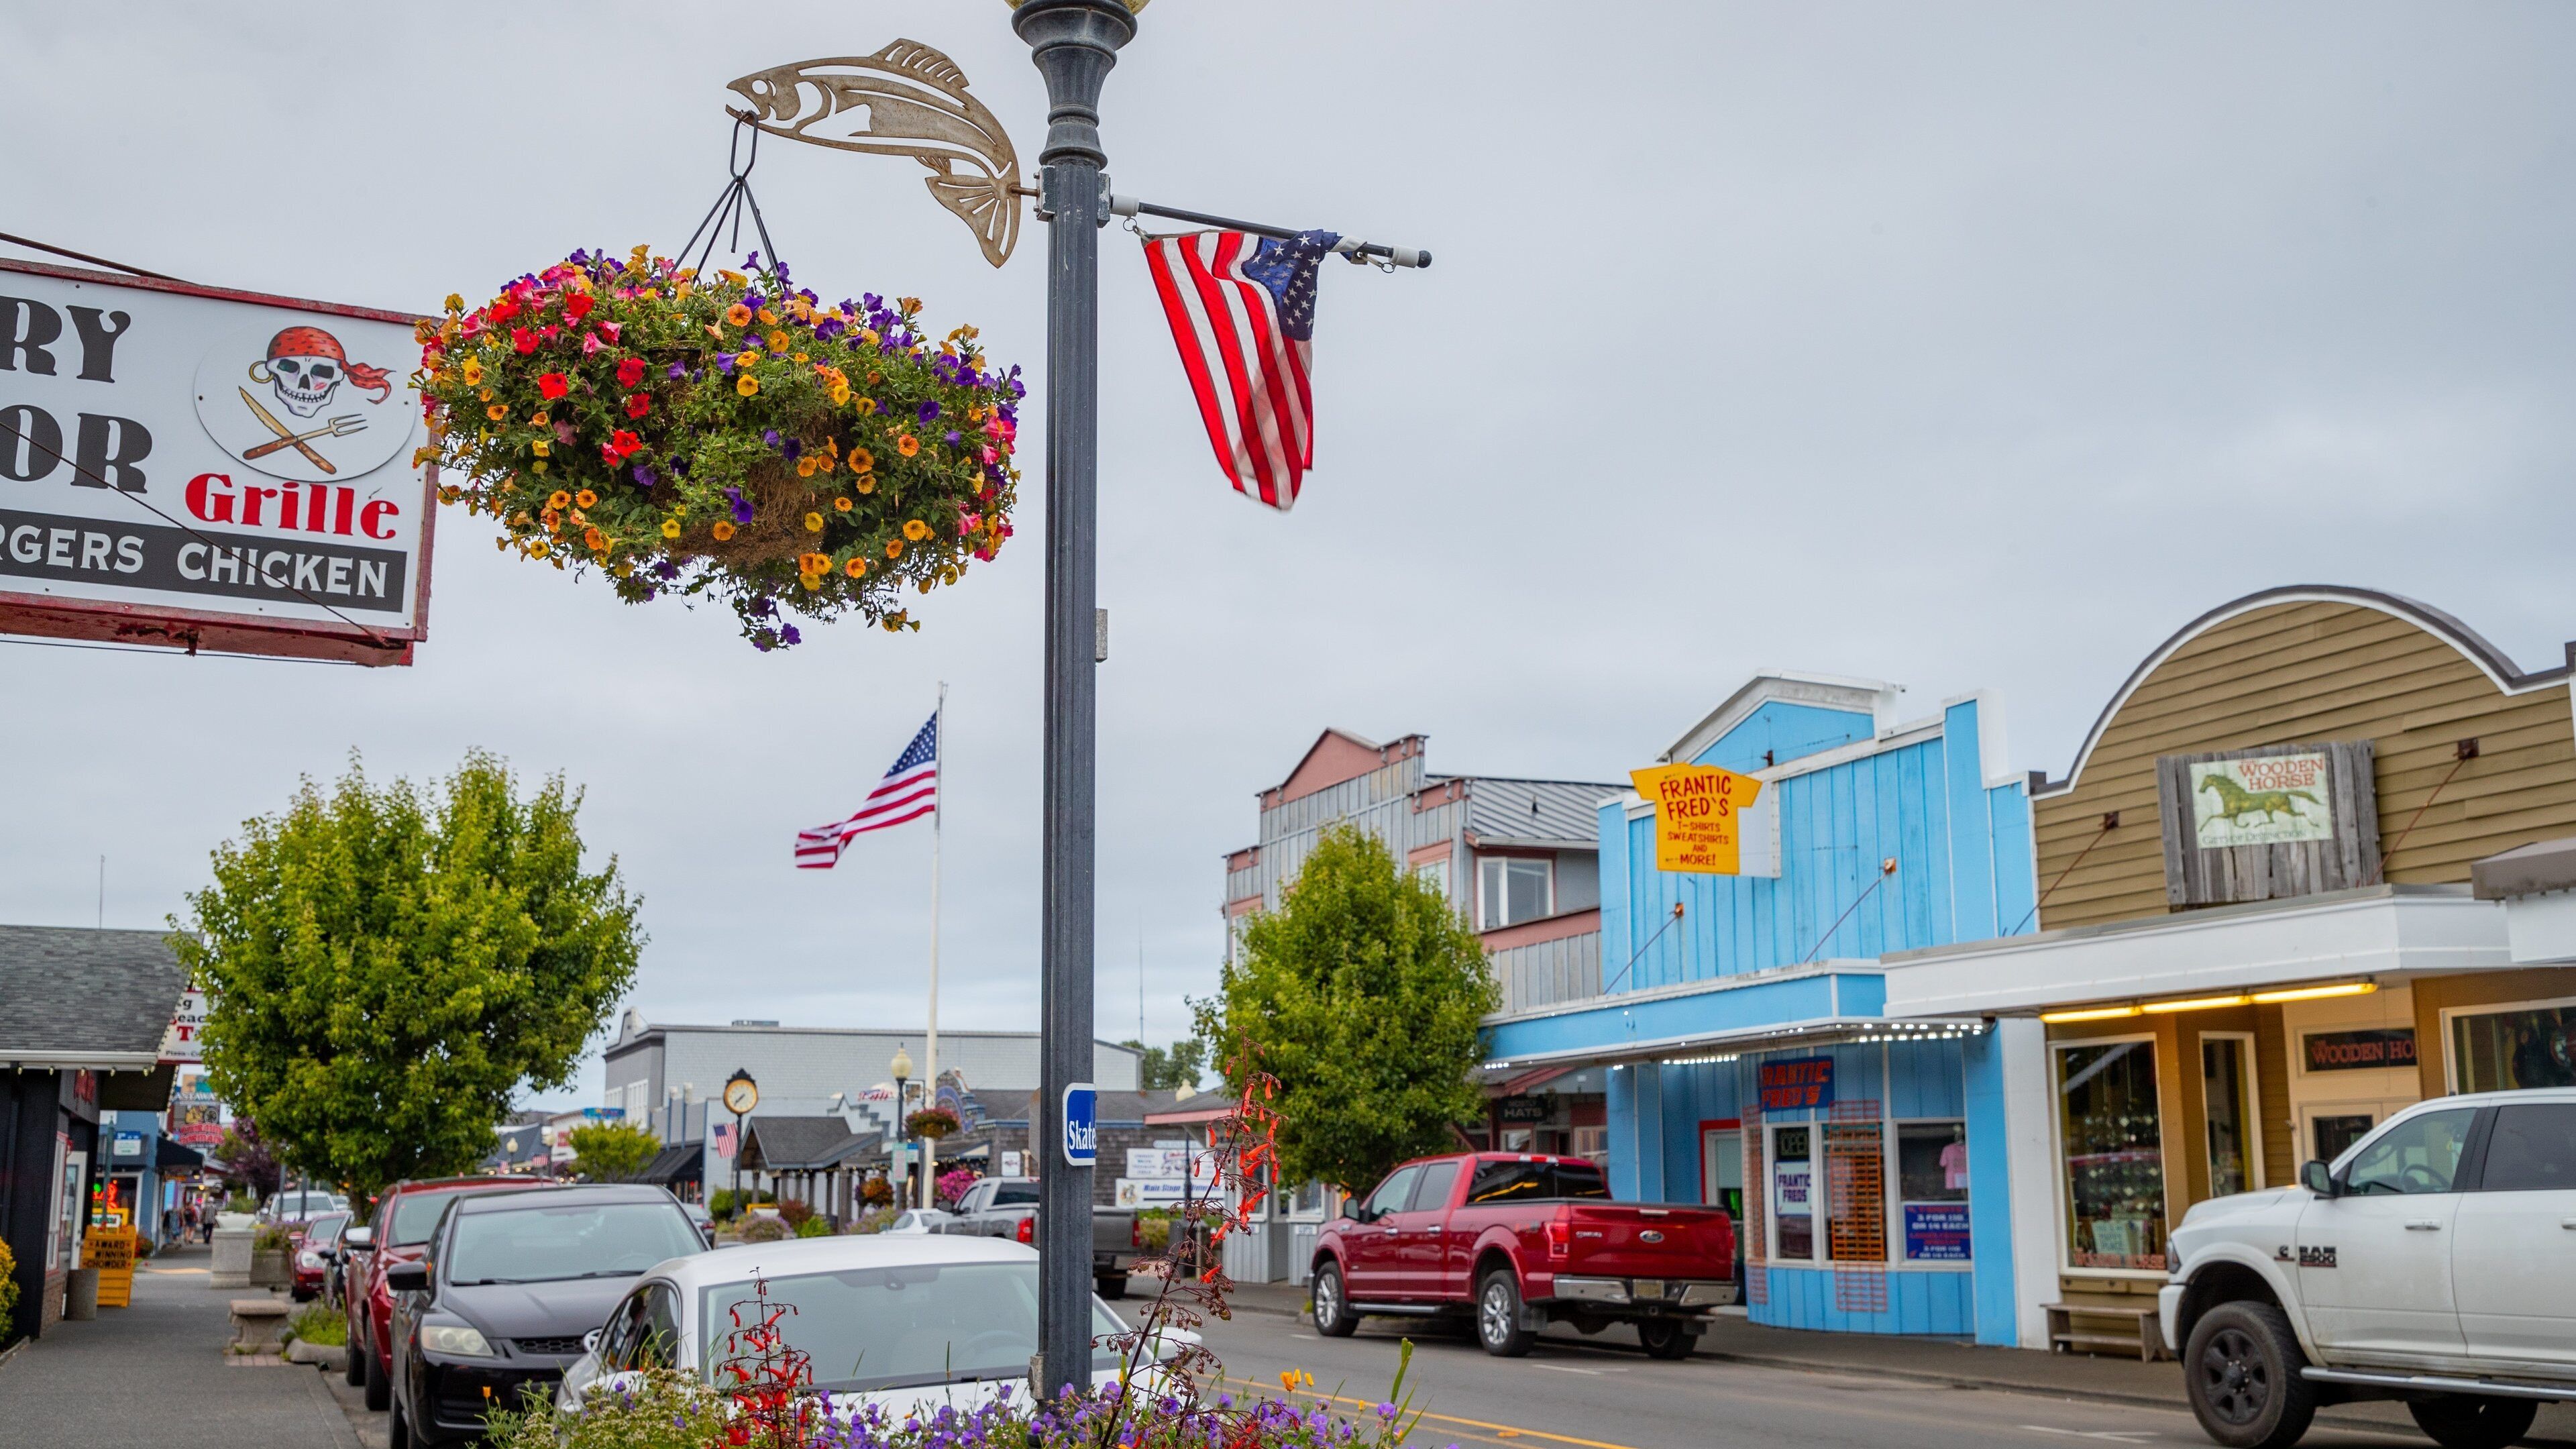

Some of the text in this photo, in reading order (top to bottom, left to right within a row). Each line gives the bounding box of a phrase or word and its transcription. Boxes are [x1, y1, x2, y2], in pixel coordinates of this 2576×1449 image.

[0, 296, 131, 384] RY
[0, 404, 153, 494] OR
[184, 472, 400, 539] Grille
[0, 524, 388, 598] GERS CHICKEN
[2239, 759, 2324, 777] WOODEN
[1660, 775, 1731, 801] FRANTIC
[2249, 772, 2316, 791] HORSE
[1666, 797, 1729, 821] FRED'S
[1677, 821, 1721, 833] T-SHIRTS
[1667, 832, 1729, 845] SWEATSHIRTS
[1692, 844, 1707, 853] AND
[1679, 853, 1716, 866] MORE!
[178, 1014, 205, 1023] eac
[2312, 1039, 2415, 1063] WOODEN HO
[1778, 1174, 1810, 1187] FRANTIC
[95, 1240, 125, 1248] AWARD
[2299, 1246, 2336, 1254] RAM
[87, 1260, 127, 1269] CHOWDER
